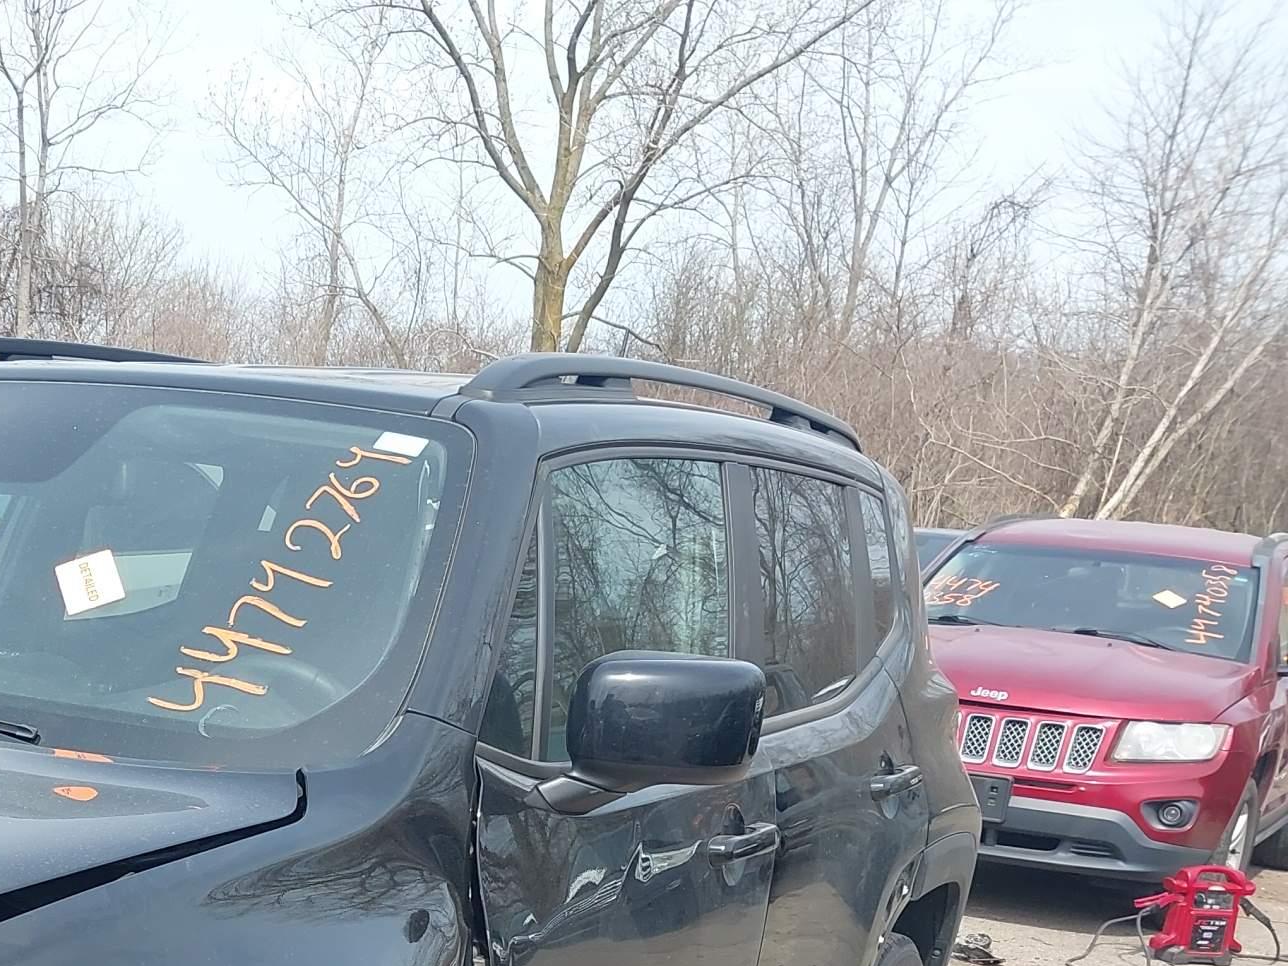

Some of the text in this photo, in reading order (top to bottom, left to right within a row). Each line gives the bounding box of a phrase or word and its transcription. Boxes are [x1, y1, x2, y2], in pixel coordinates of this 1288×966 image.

[78, 561, 100, 602] DETAILED
[148, 446, 413, 712] 44742764
[1184, 564, 1239, 644] 44740358
[970, 686, 1009, 702] Jeep
